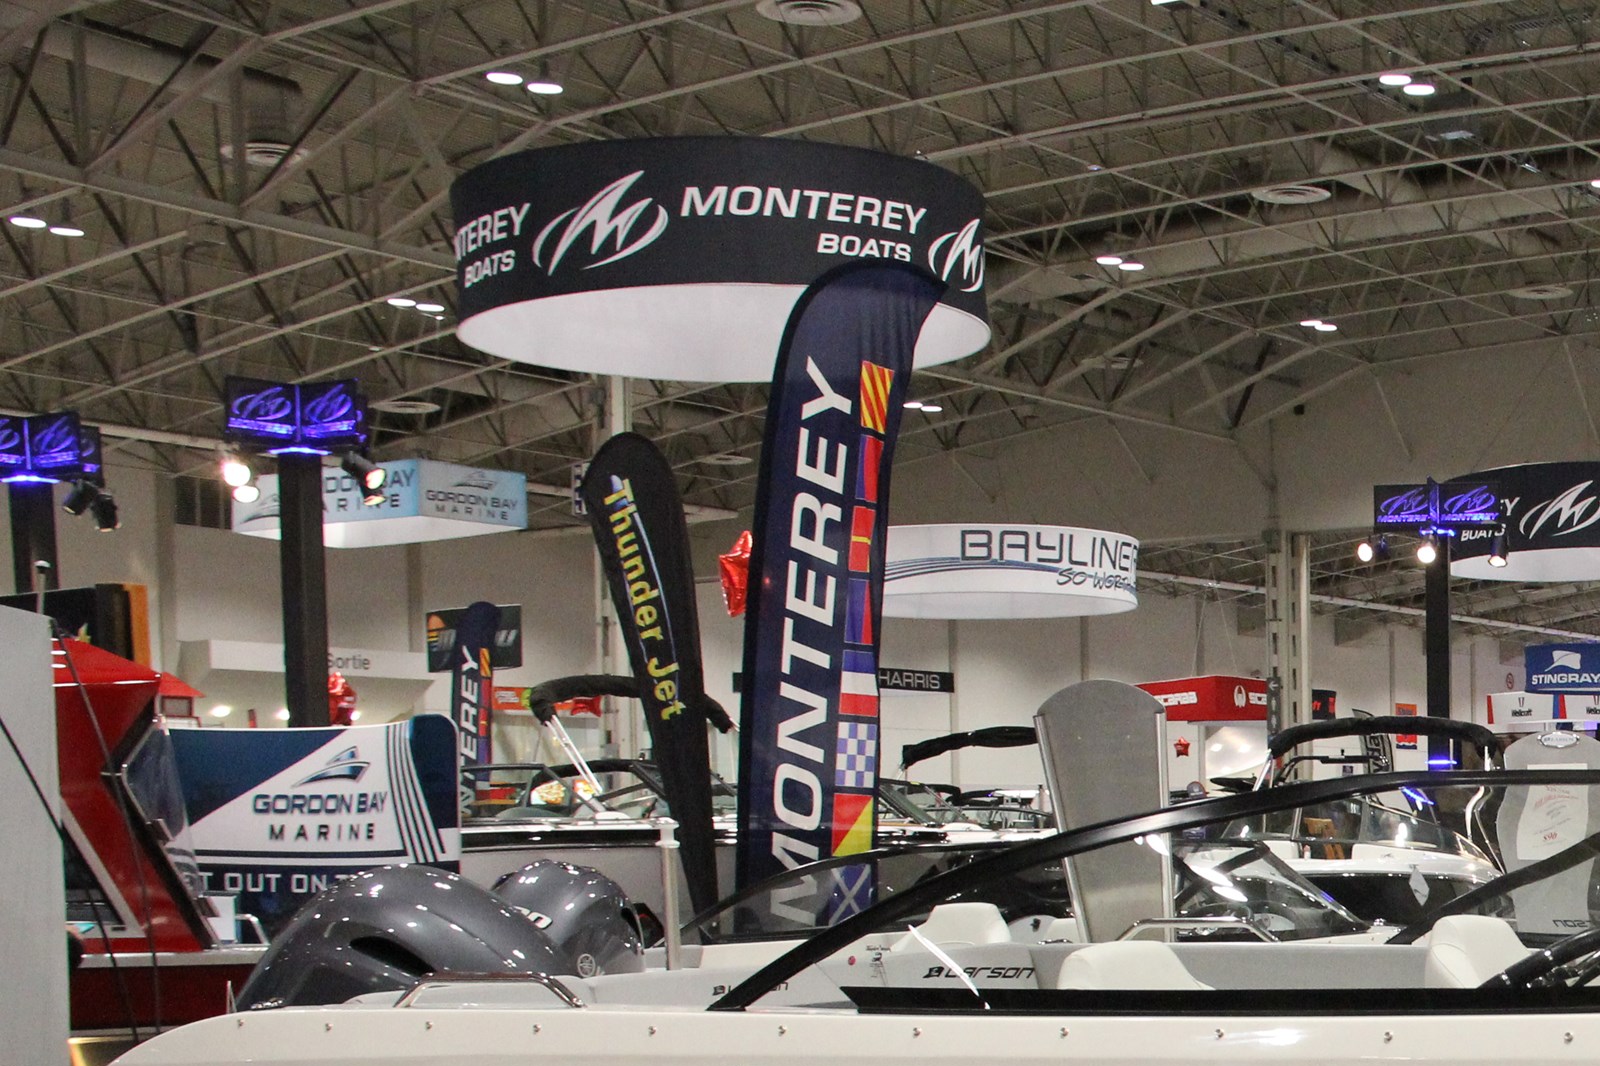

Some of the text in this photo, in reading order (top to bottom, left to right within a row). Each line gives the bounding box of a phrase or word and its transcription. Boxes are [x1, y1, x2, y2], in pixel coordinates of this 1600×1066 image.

[680, 185, 927, 235] MONTEREY
[817, 232, 912, 263] BOATS
[464, 249, 516, 288] BOATS
[425, 489, 518, 509] GORDON BAY
[435, 504, 510, 521] MARINE
[1056, 567, 1088, 587] SO
[603, 478, 687, 721] Thunder Jet
[771, 355, 852, 927] MONTEREY
[879, 670, 941, 690] HARRIS
[253, 791, 389, 815] GORDON BAY
[269, 823, 375, 841] MARINE
[224, 872, 282, 893] OUT
[290, 873, 328, 894] ON
